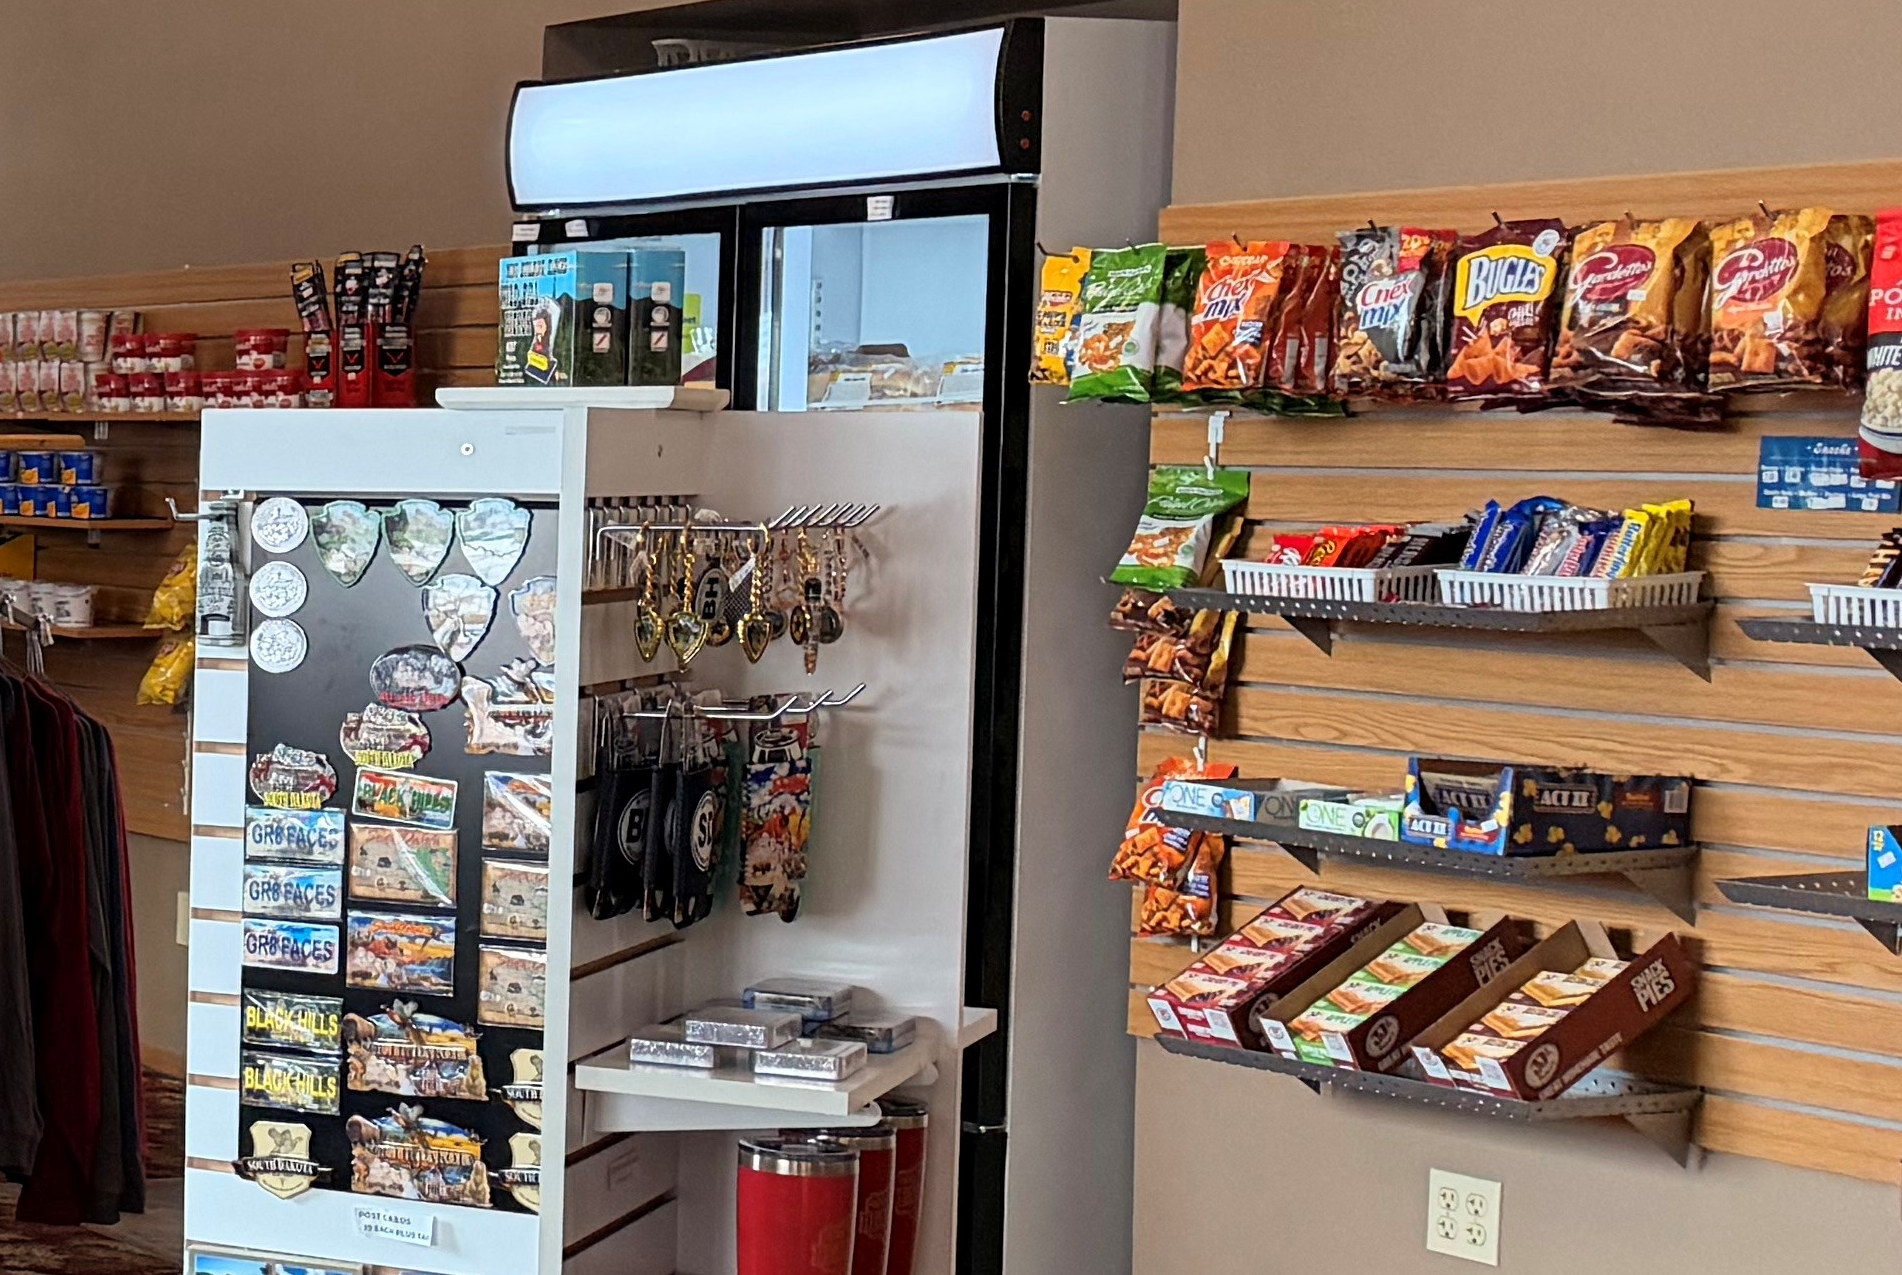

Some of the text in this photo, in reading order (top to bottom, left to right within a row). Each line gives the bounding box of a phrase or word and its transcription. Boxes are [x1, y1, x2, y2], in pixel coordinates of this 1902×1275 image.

[1204, 274, 1255, 303] Chex
[1360, 279, 1412, 308] Chex
[1464, 255, 1545, 310] BUGLES
[702, 576, 721, 620] BH
[1171, 784, 1207, 808] ONE
[1441, 789, 1469, 807] ACT
[1538, 789, 1570, 806] ACT
[628, 807, 644, 835] B
[1306, 803, 1347, 827] ONE
[1410, 818, 1432, 832] ACT
[251, 823, 339, 850] GR8 FACES
[248, 880, 336, 906] GR8 FACES
[245, 932, 333, 963] GR8 FACES
[1470, 937, 1505, 968] SNACK
[1630, 958, 1668, 989] SNACK
[1635, 969, 1676, 1013] PIES
[246, 1004, 339, 1037] BLACK HILLS
[244, 1067, 337, 1099] BLACK HILLS
[247, 1159, 316, 1174] SOUTH DAKOTA
[504, 1169, 535, 1183] SOUTH
[358, 1210, 411, 1225] POST CARDS
